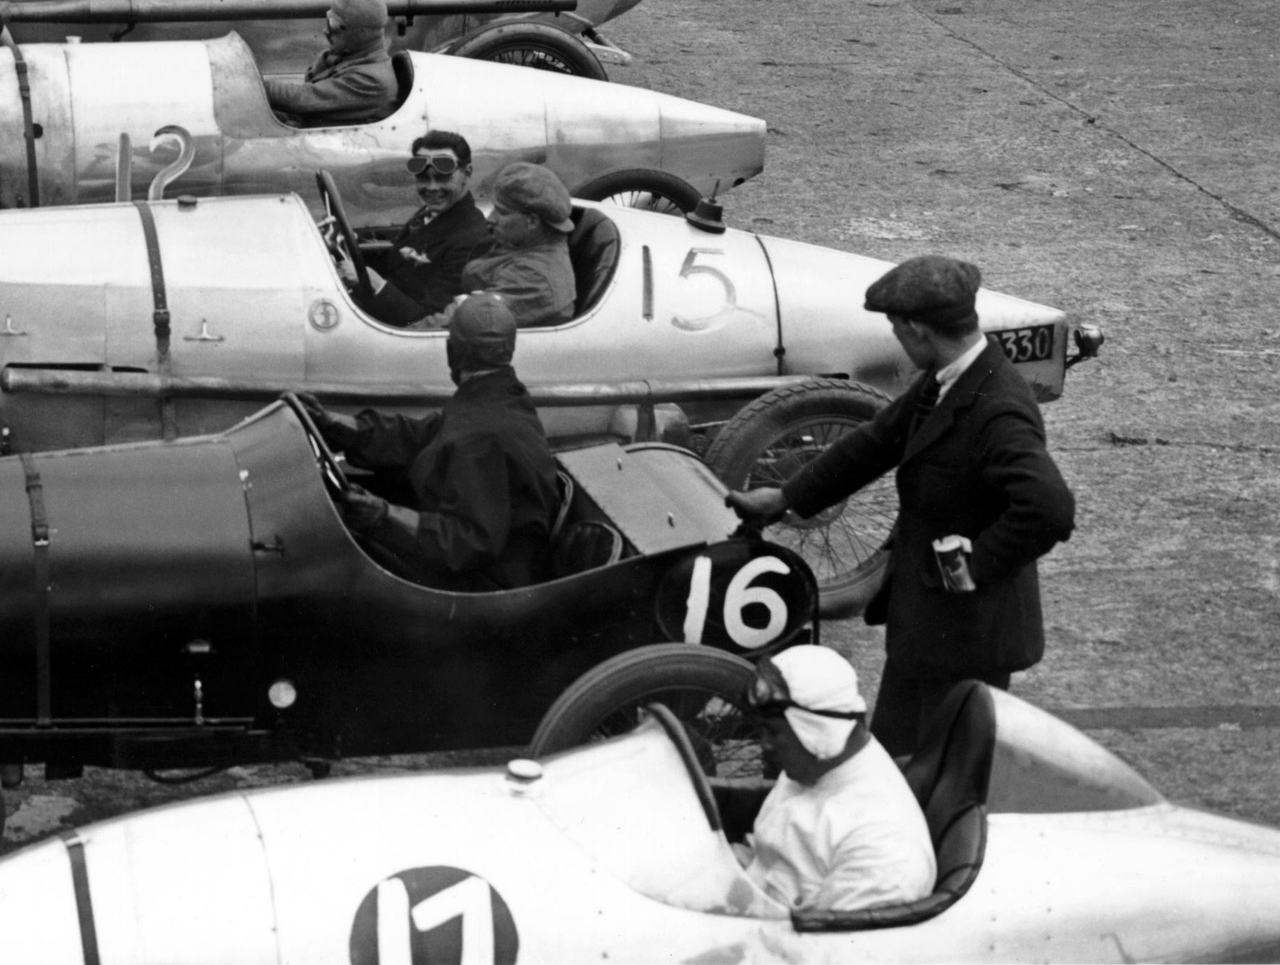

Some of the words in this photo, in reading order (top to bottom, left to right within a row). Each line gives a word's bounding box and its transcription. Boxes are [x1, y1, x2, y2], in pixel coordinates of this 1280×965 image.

[115, 125, 195, 201] 12
[642, 245, 737, 333] 15
[989, 327, 1049, 361] 330
[683, 555, 791, 649] 16
[377, 875, 495, 964] 17
